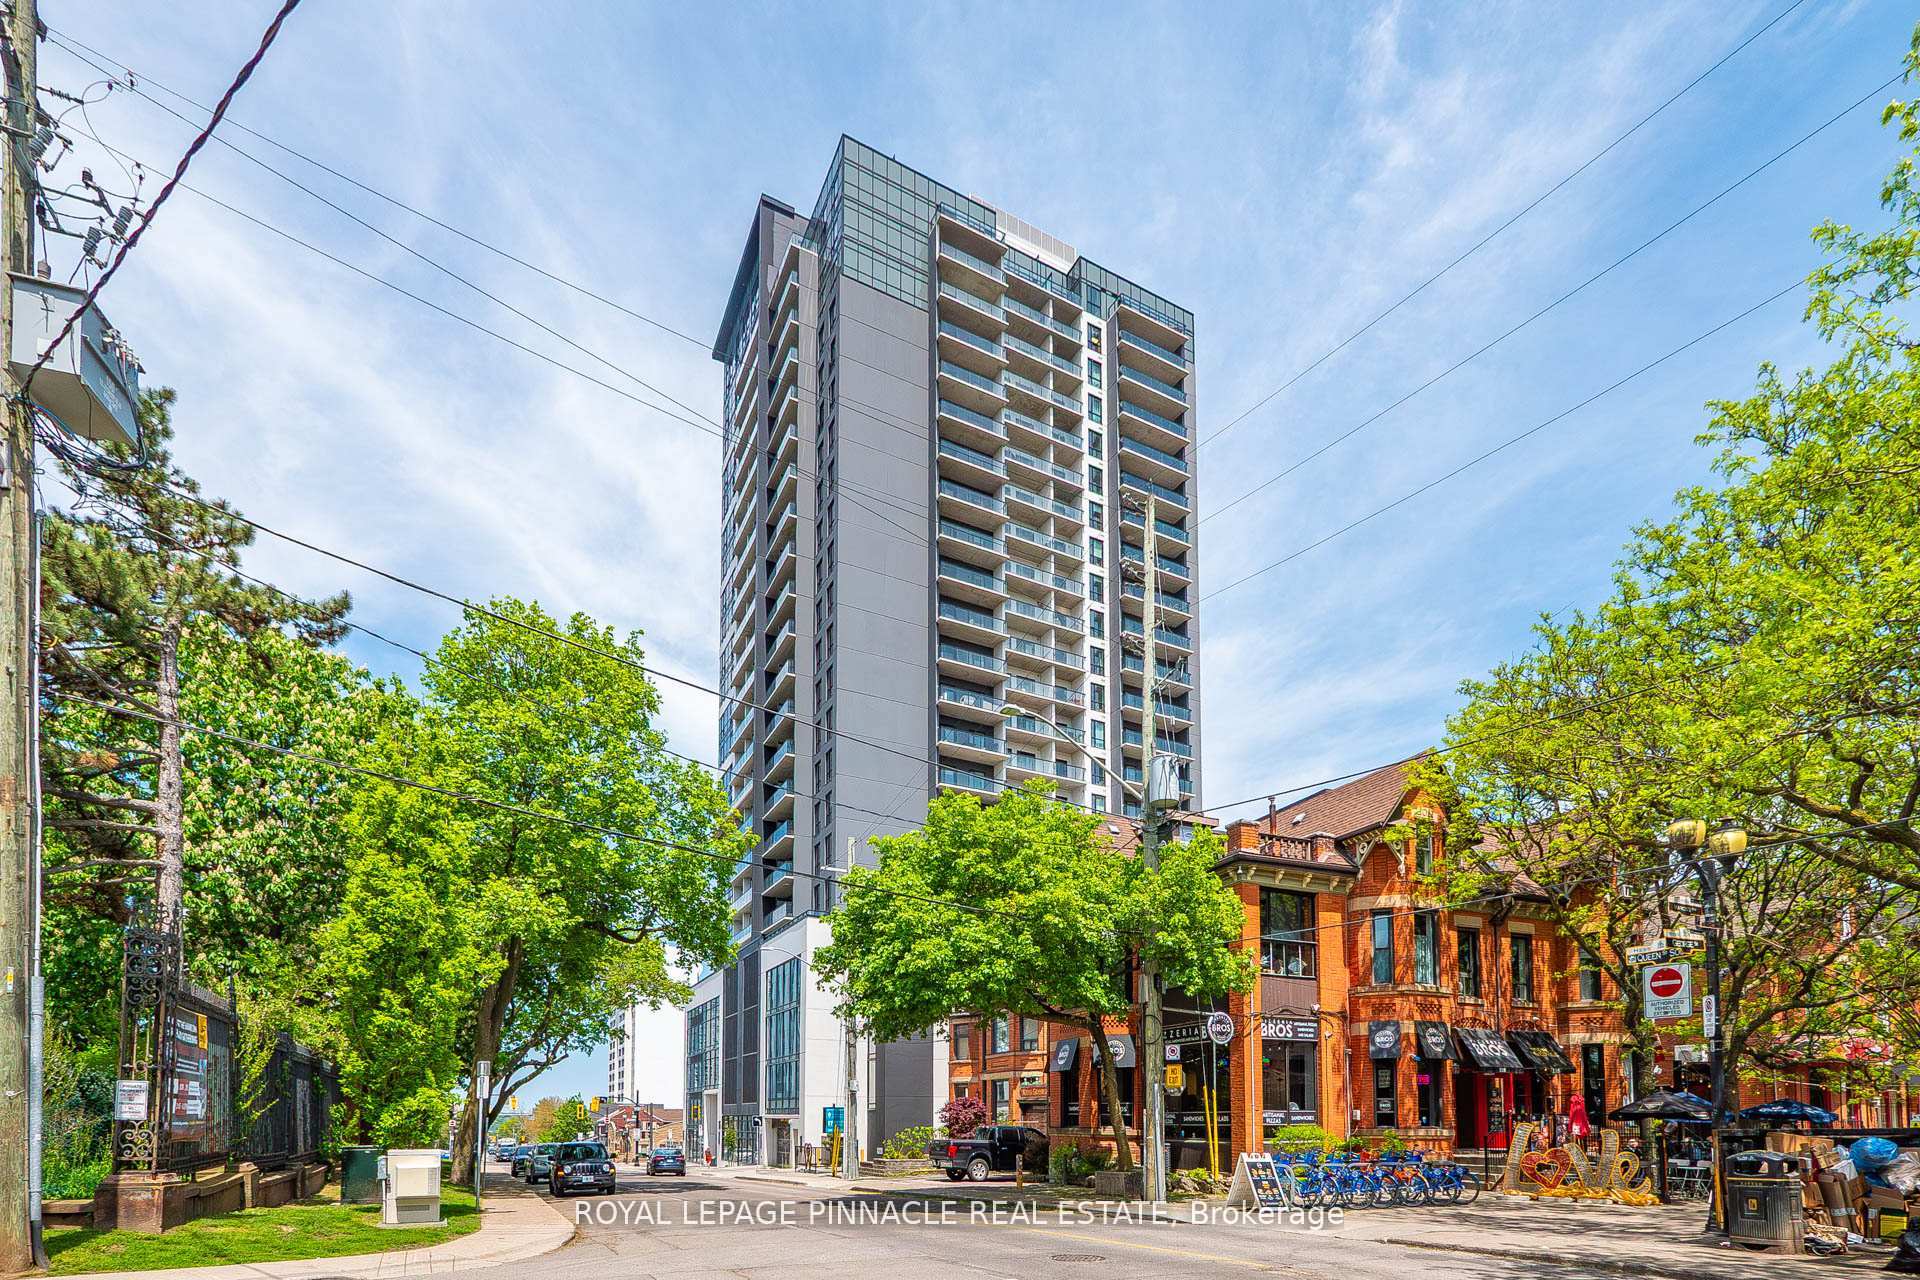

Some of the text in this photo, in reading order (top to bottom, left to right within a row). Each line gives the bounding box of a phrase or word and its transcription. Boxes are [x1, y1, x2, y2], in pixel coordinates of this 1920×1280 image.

[1637, 953, 1661, 962] QUEEN
[1211, 1024, 1231, 1033] BROS
[1261, 1022, 1293, 1038] BROS
[1472, 1042, 1508, 1057] BROS
